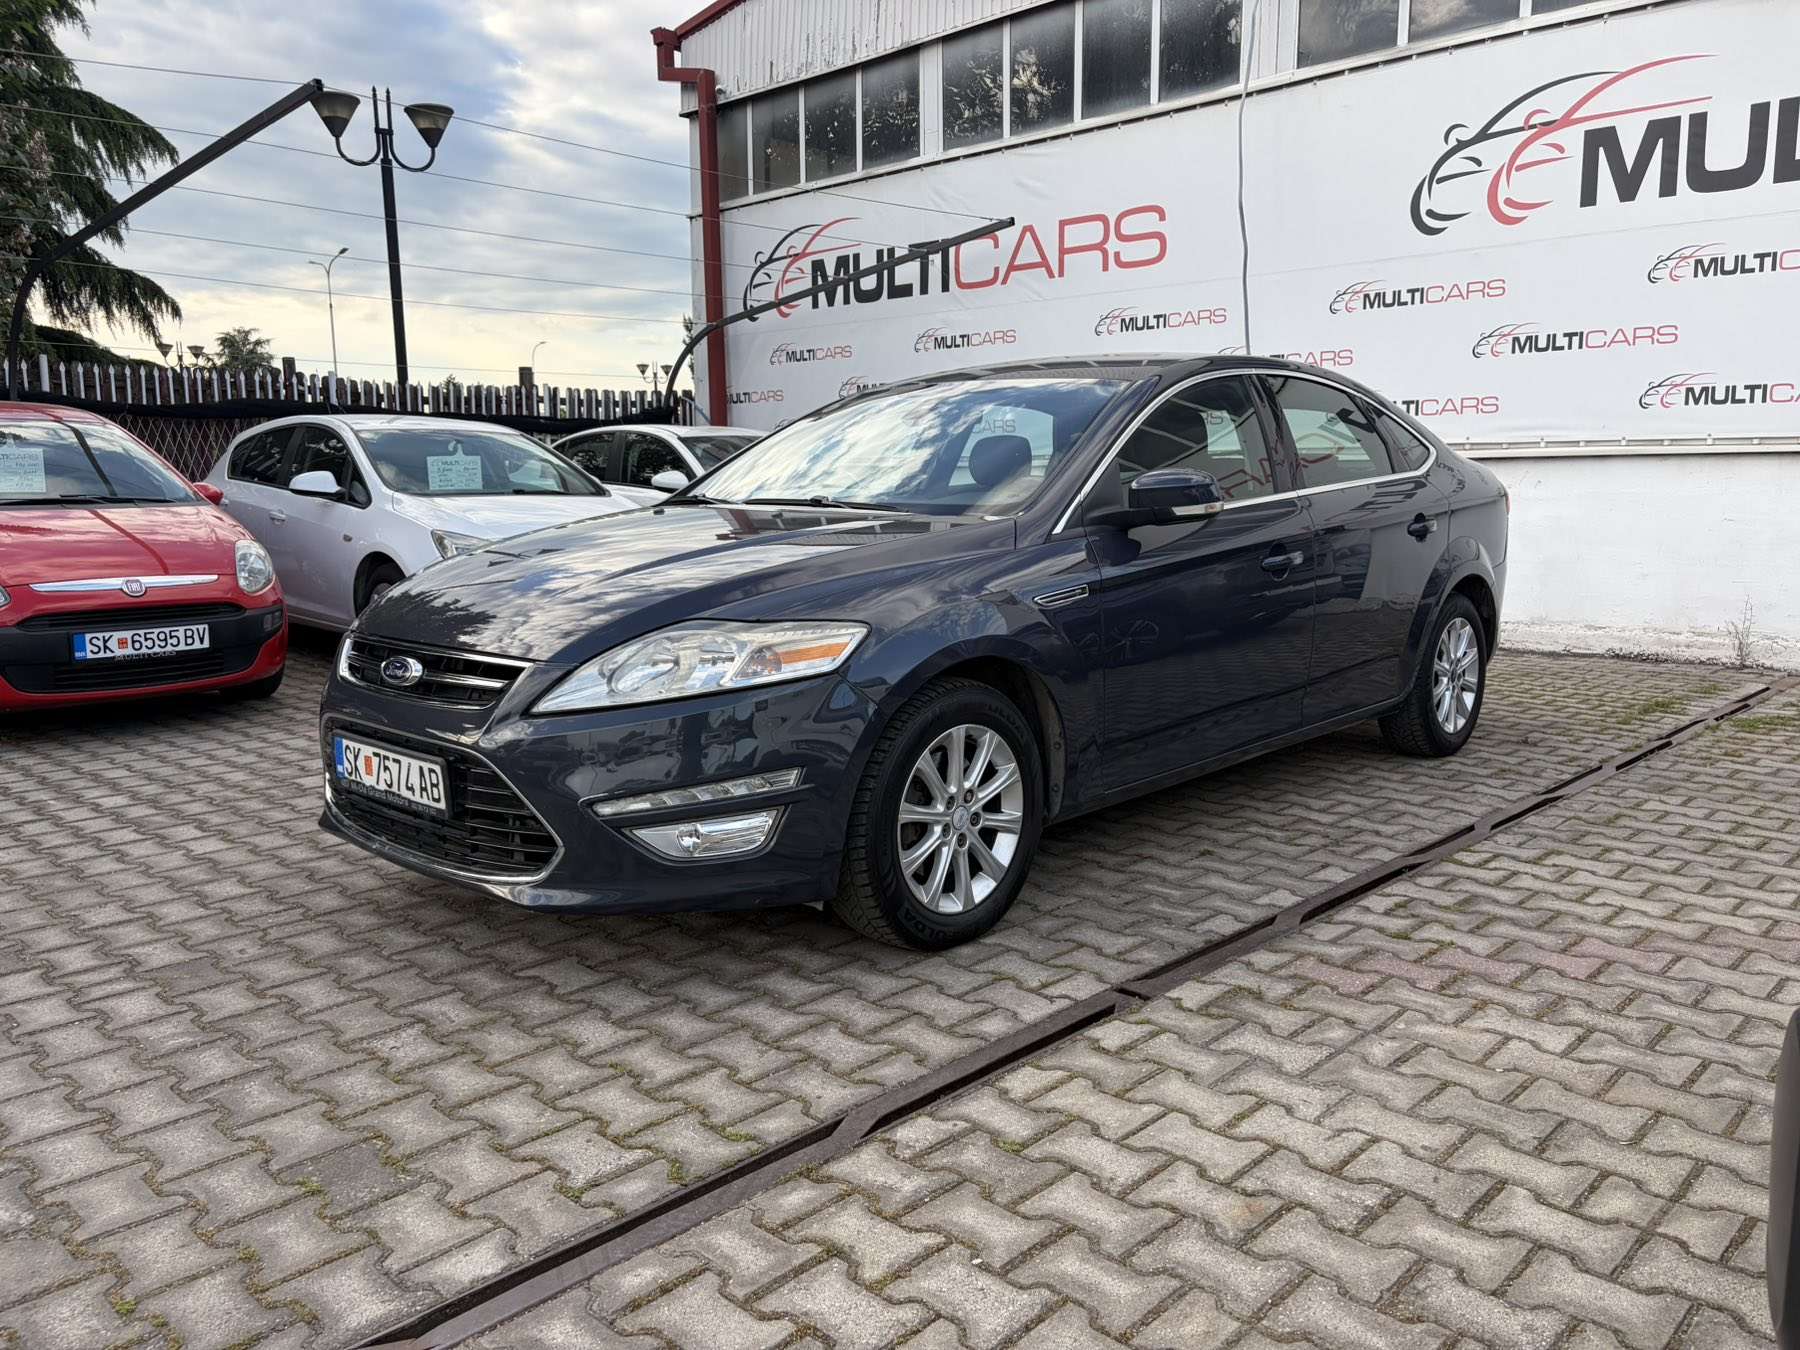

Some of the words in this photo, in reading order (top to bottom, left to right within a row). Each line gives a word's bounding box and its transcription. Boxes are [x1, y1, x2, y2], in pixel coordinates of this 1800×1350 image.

[811, 204, 1168, 310] MULTICARS
[1362, 278, 1507, 311] MULTICARS
[1120, 307, 1228, 334] MULTICARS
[933, 328, 1017, 351] MULTICARS
[1511, 324, 1679, 355] MULTICARS
[785, 344, 853, 366] MULTICARS
[1393, 396, 1500, 417] TICARS
[1684, 382, 1800, 407] MULTIC
[127, 581, 141, 591] FIAT
[88, 634, 115, 655] SK
[131, 629, 180, 651] 6595
[184, 626, 206, 647] BV
[386, 662, 410, 677] Ford
[344, 743, 363, 782] SK
[373, 751, 415, 797] 7574
[418, 764, 442, 804] AB
